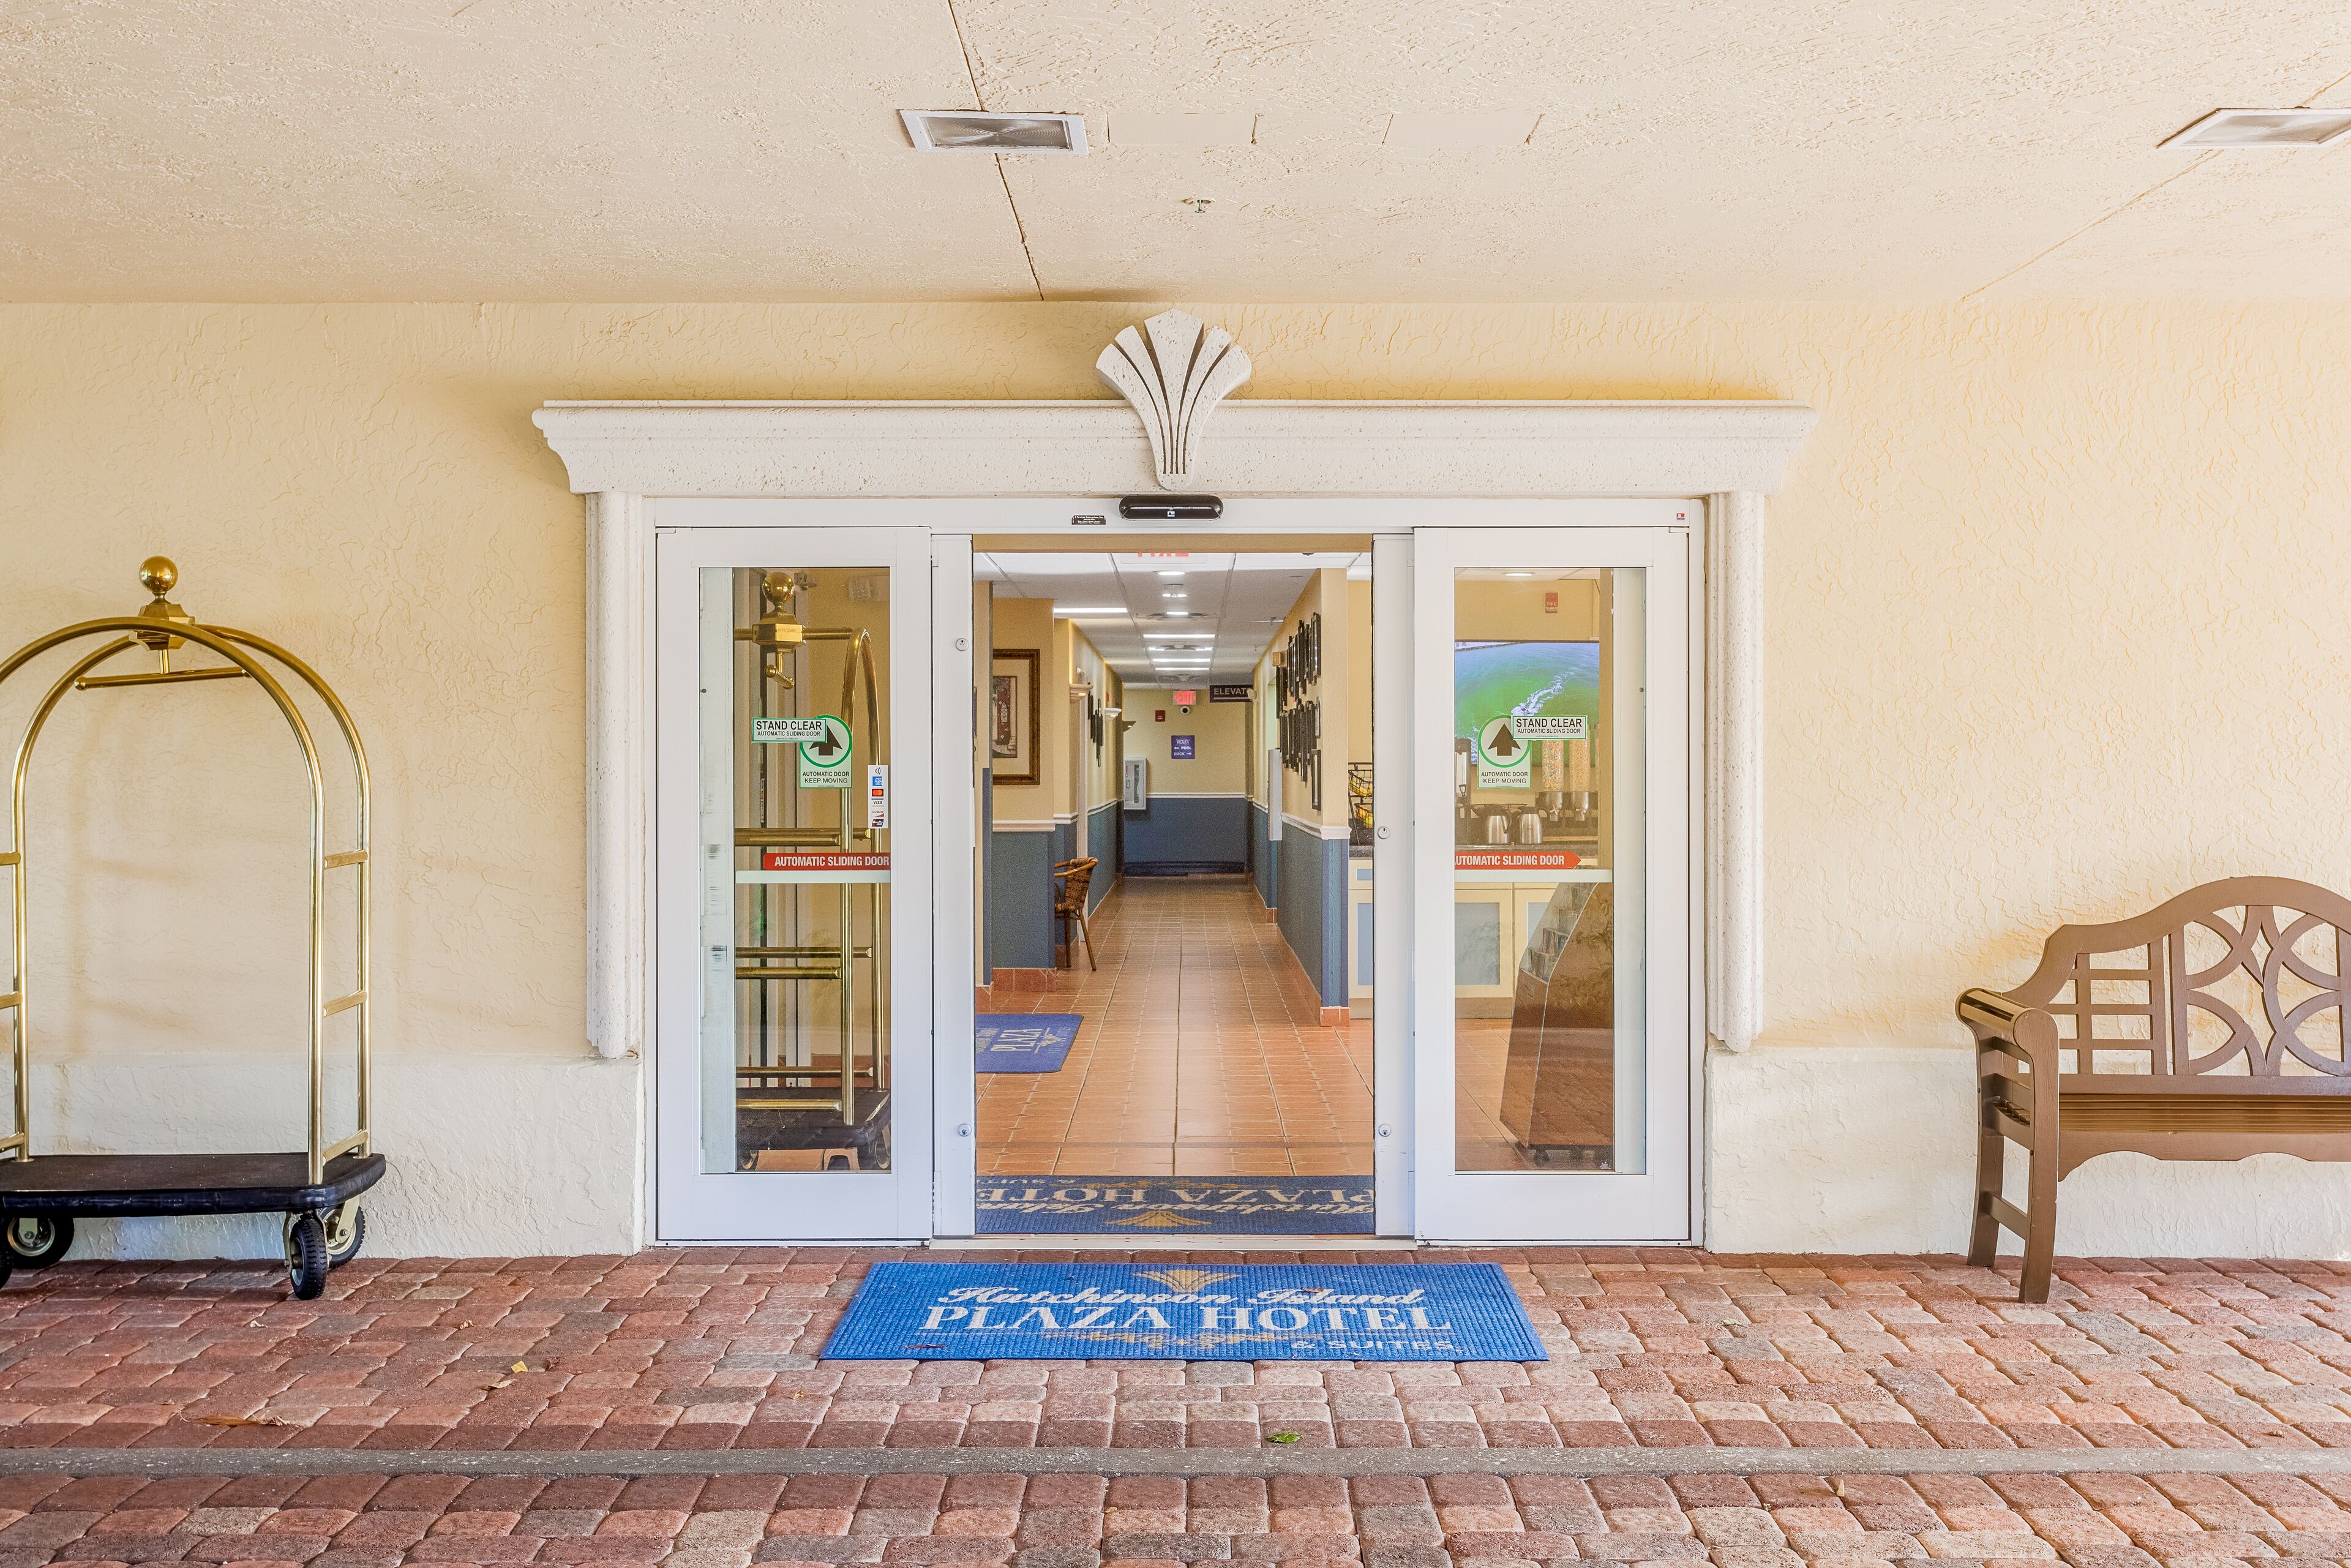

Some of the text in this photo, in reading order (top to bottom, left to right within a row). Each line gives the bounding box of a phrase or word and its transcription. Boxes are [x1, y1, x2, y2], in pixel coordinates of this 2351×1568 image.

[1177, 691, 1193, 704] EXIT
[756, 721, 822, 730] STAND CLEAR
[1516, 718, 1582, 727] STAND CLEAR
[774, 856, 890, 866] AUTOMATIC SLIDING DOOR
[1502, 855, 1537, 865] SLIDING
[1540, 855, 1565, 865] DOOR
[990, 1029, 1042, 1051] PLAZA
[976, 1188, 1373, 1202] PLAZA HOTE
[976, 1203, 1104, 1214] Islan
[938, 1286, 1425, 1305] Hutchinson Island
[918, 1306, 1450, 1330] PLAZA HOTEL
[1328, 1340, 1453, 1349] SUITES
